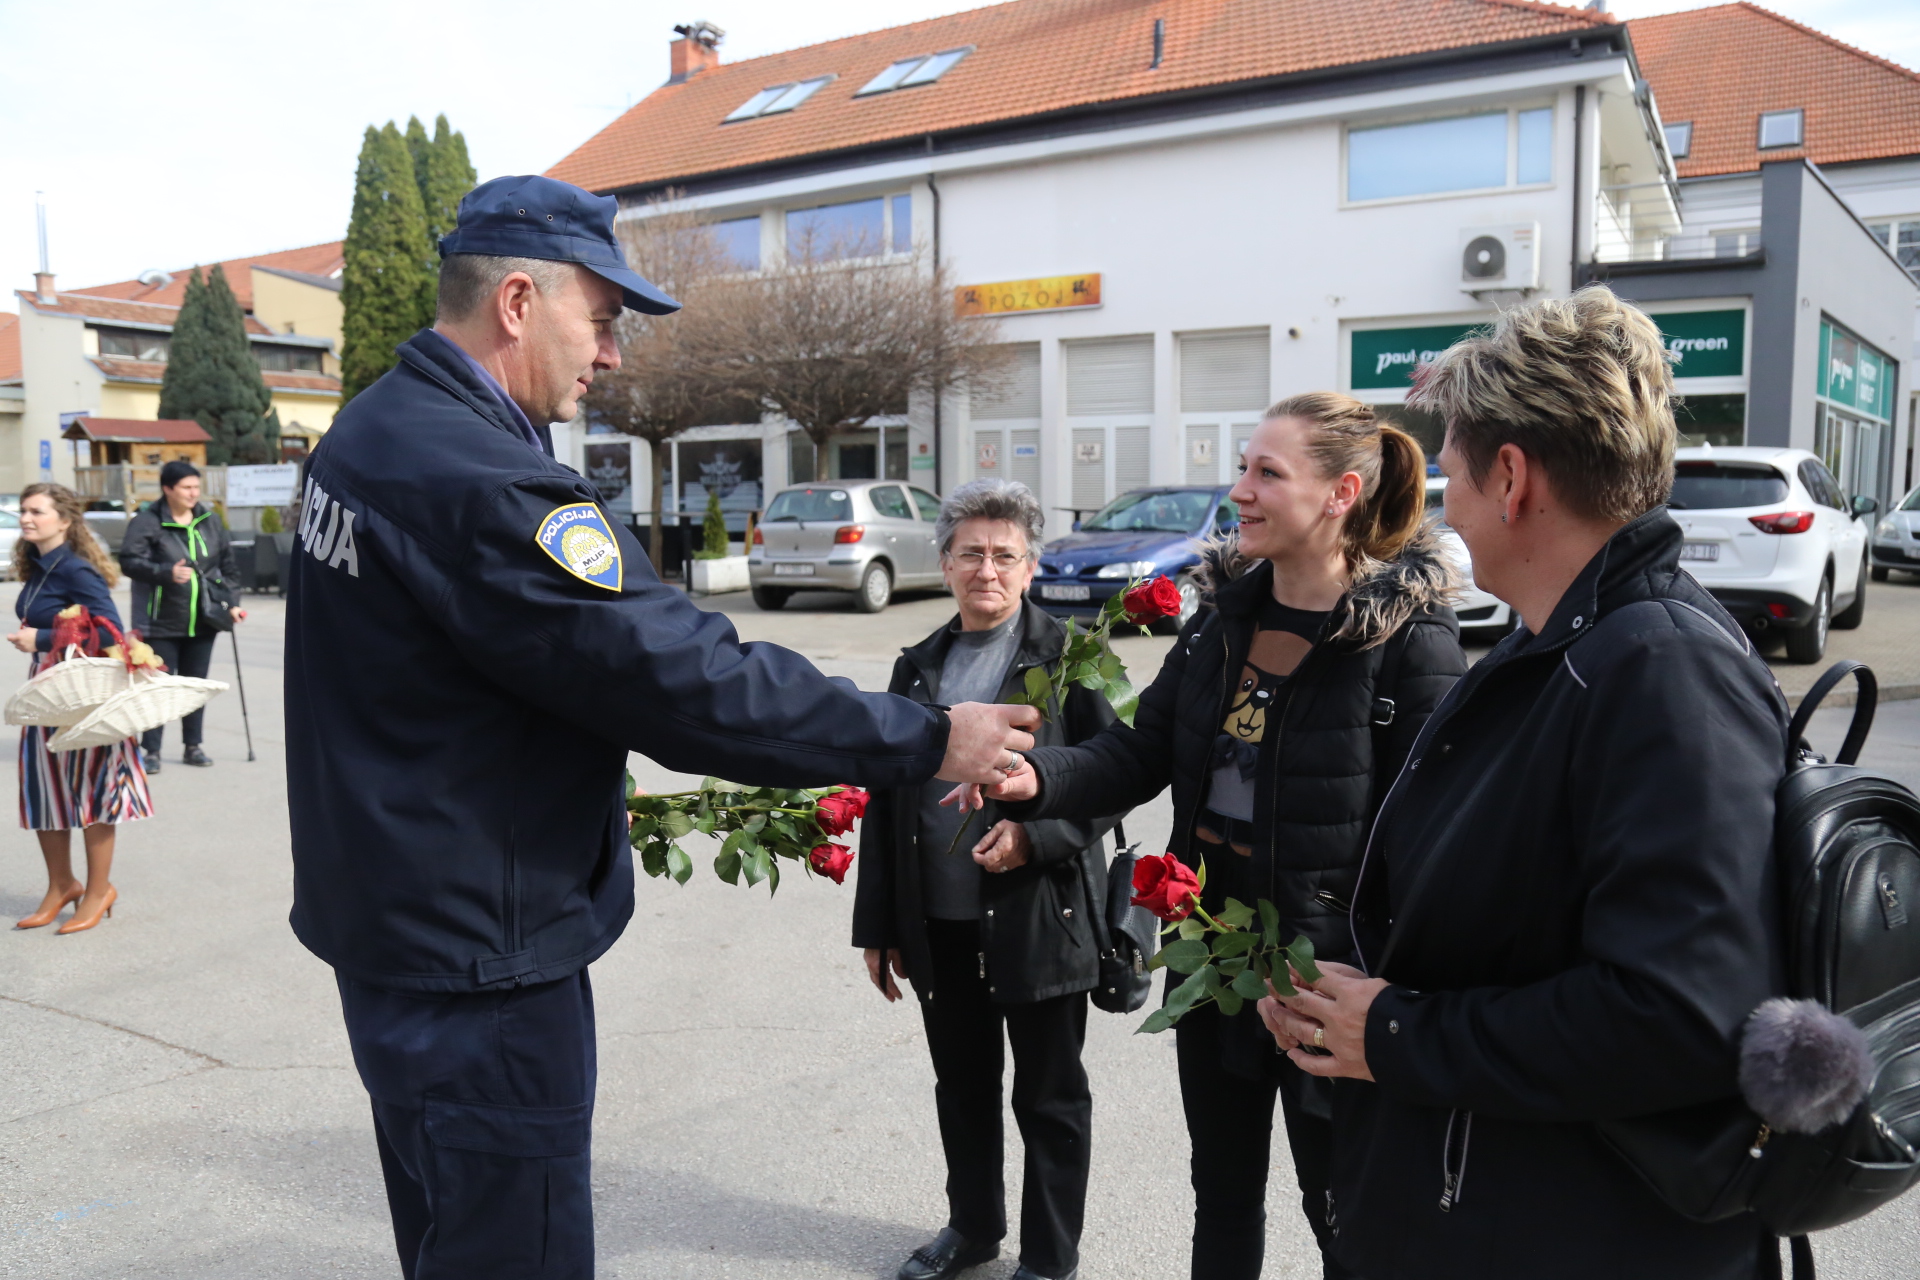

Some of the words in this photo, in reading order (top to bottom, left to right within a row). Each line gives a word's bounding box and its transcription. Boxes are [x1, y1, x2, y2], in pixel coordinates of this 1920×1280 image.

[989, 290, 1063, 310] POZOJ
[1669, 336, 1728, 361] green
[1375, 348, 1416, 375] paul
[297, 473, 359, 578] ICIJA
[542, 510, 597, 545] POLICIJA
[572, 537, 599, 558] RH
[582, 549, 605, 567] MUP
